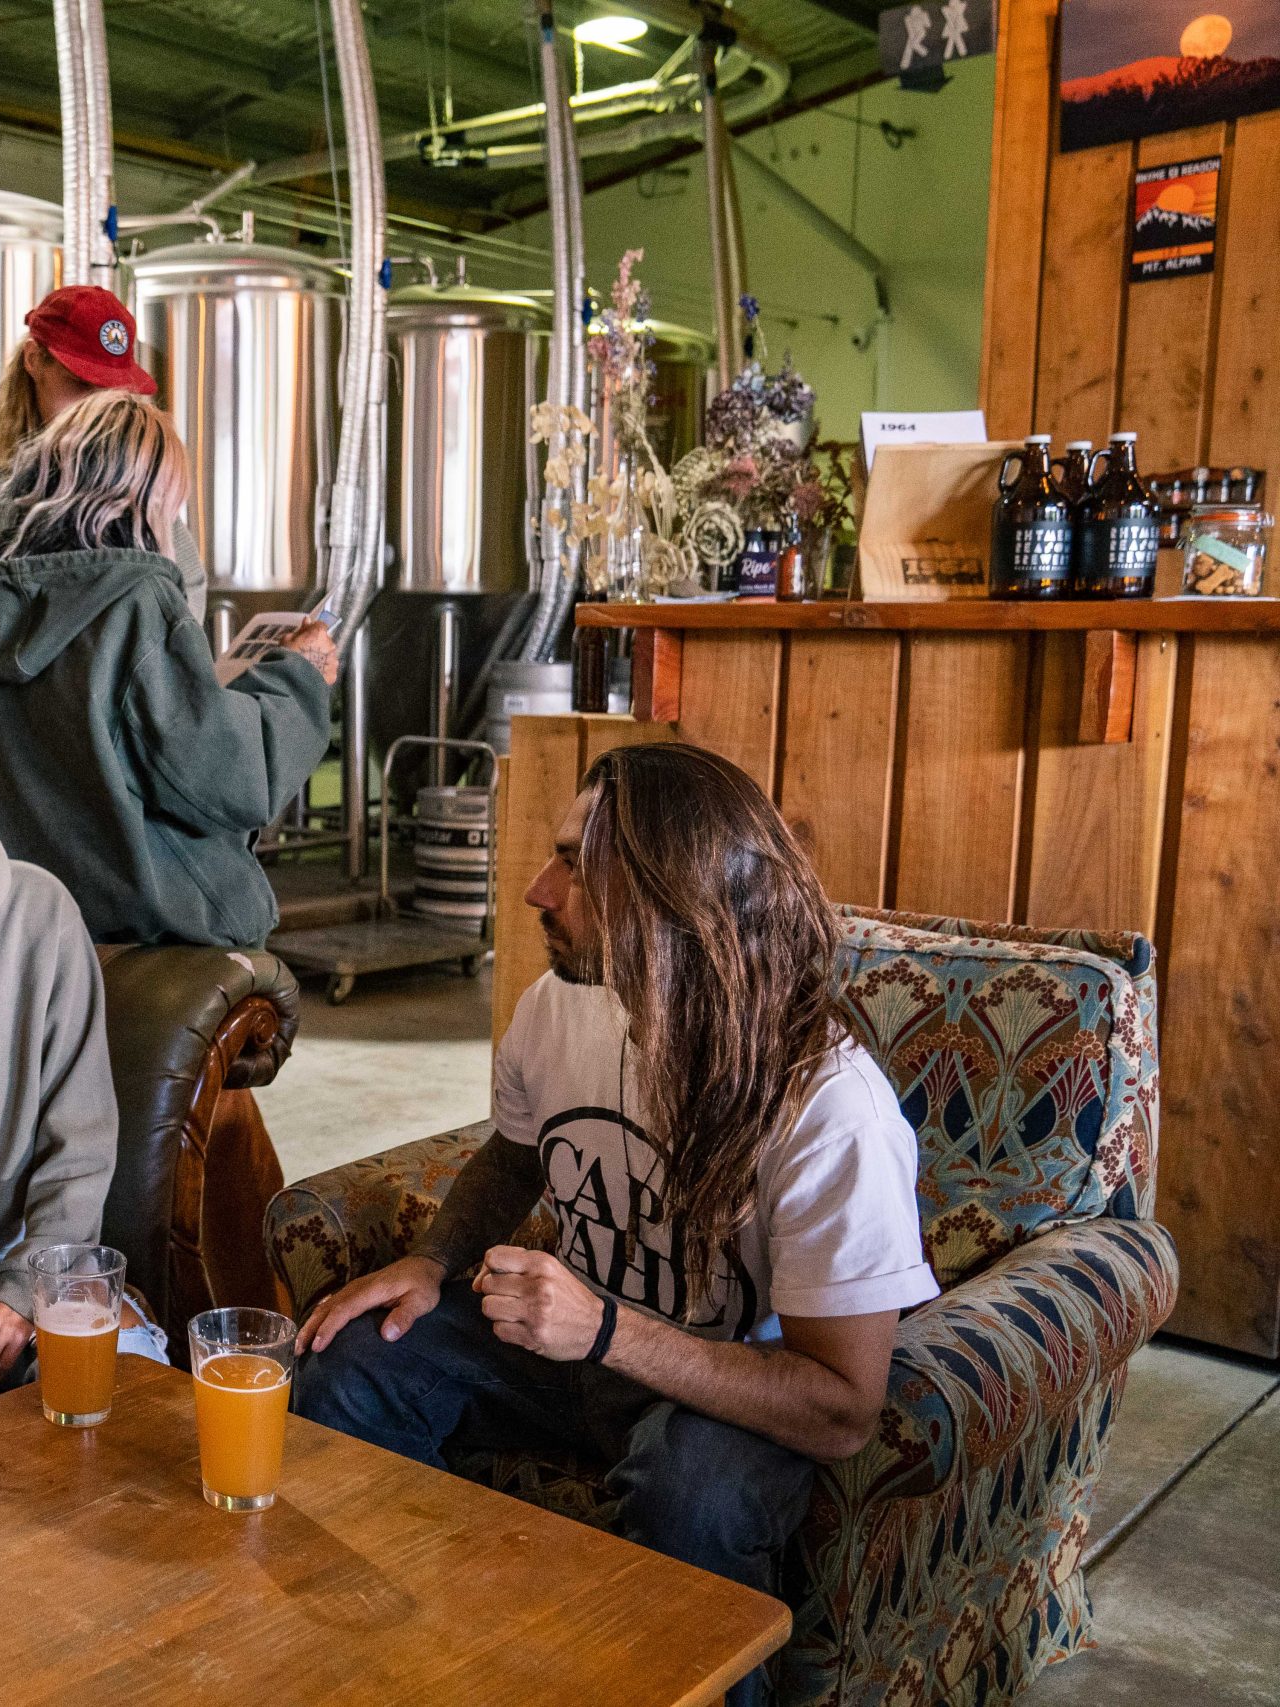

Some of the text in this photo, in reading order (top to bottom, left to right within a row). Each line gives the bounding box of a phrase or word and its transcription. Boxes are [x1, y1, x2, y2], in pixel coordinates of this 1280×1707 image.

[1135, 168, 1165, 184] RHYME
[1181, 159, 1220, 176] REASON
[881, 423, 916, 431] 1964
[741, 557, 771, 579] Ripe
